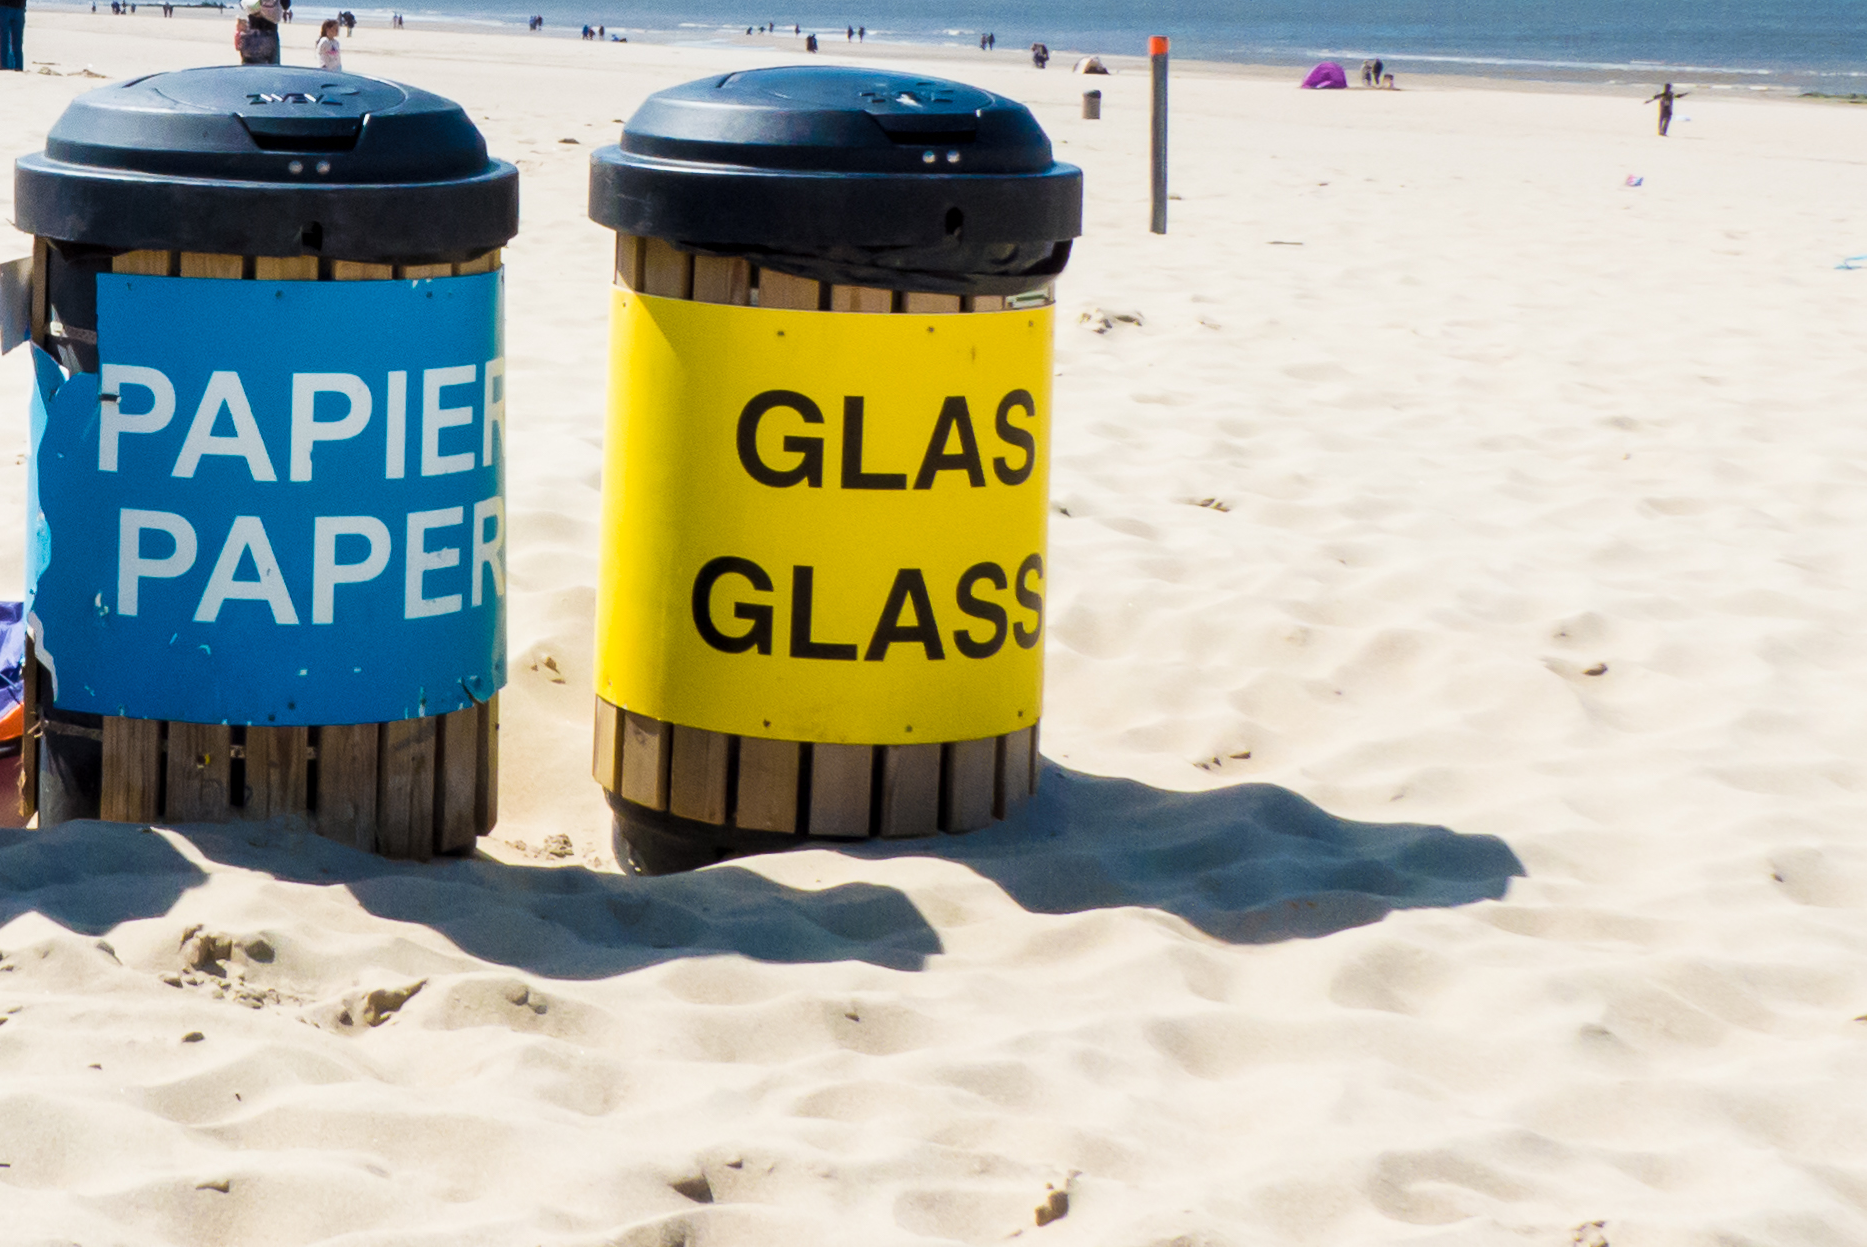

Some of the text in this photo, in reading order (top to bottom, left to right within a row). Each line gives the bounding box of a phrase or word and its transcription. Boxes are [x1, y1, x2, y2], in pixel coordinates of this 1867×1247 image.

[97, 355, 505, 482] PAPIER
[736, 388, 1036, 491] GLAS
[117, 495, 506, 625] PAPER
[691, 552, 1044, 662] GLASS
